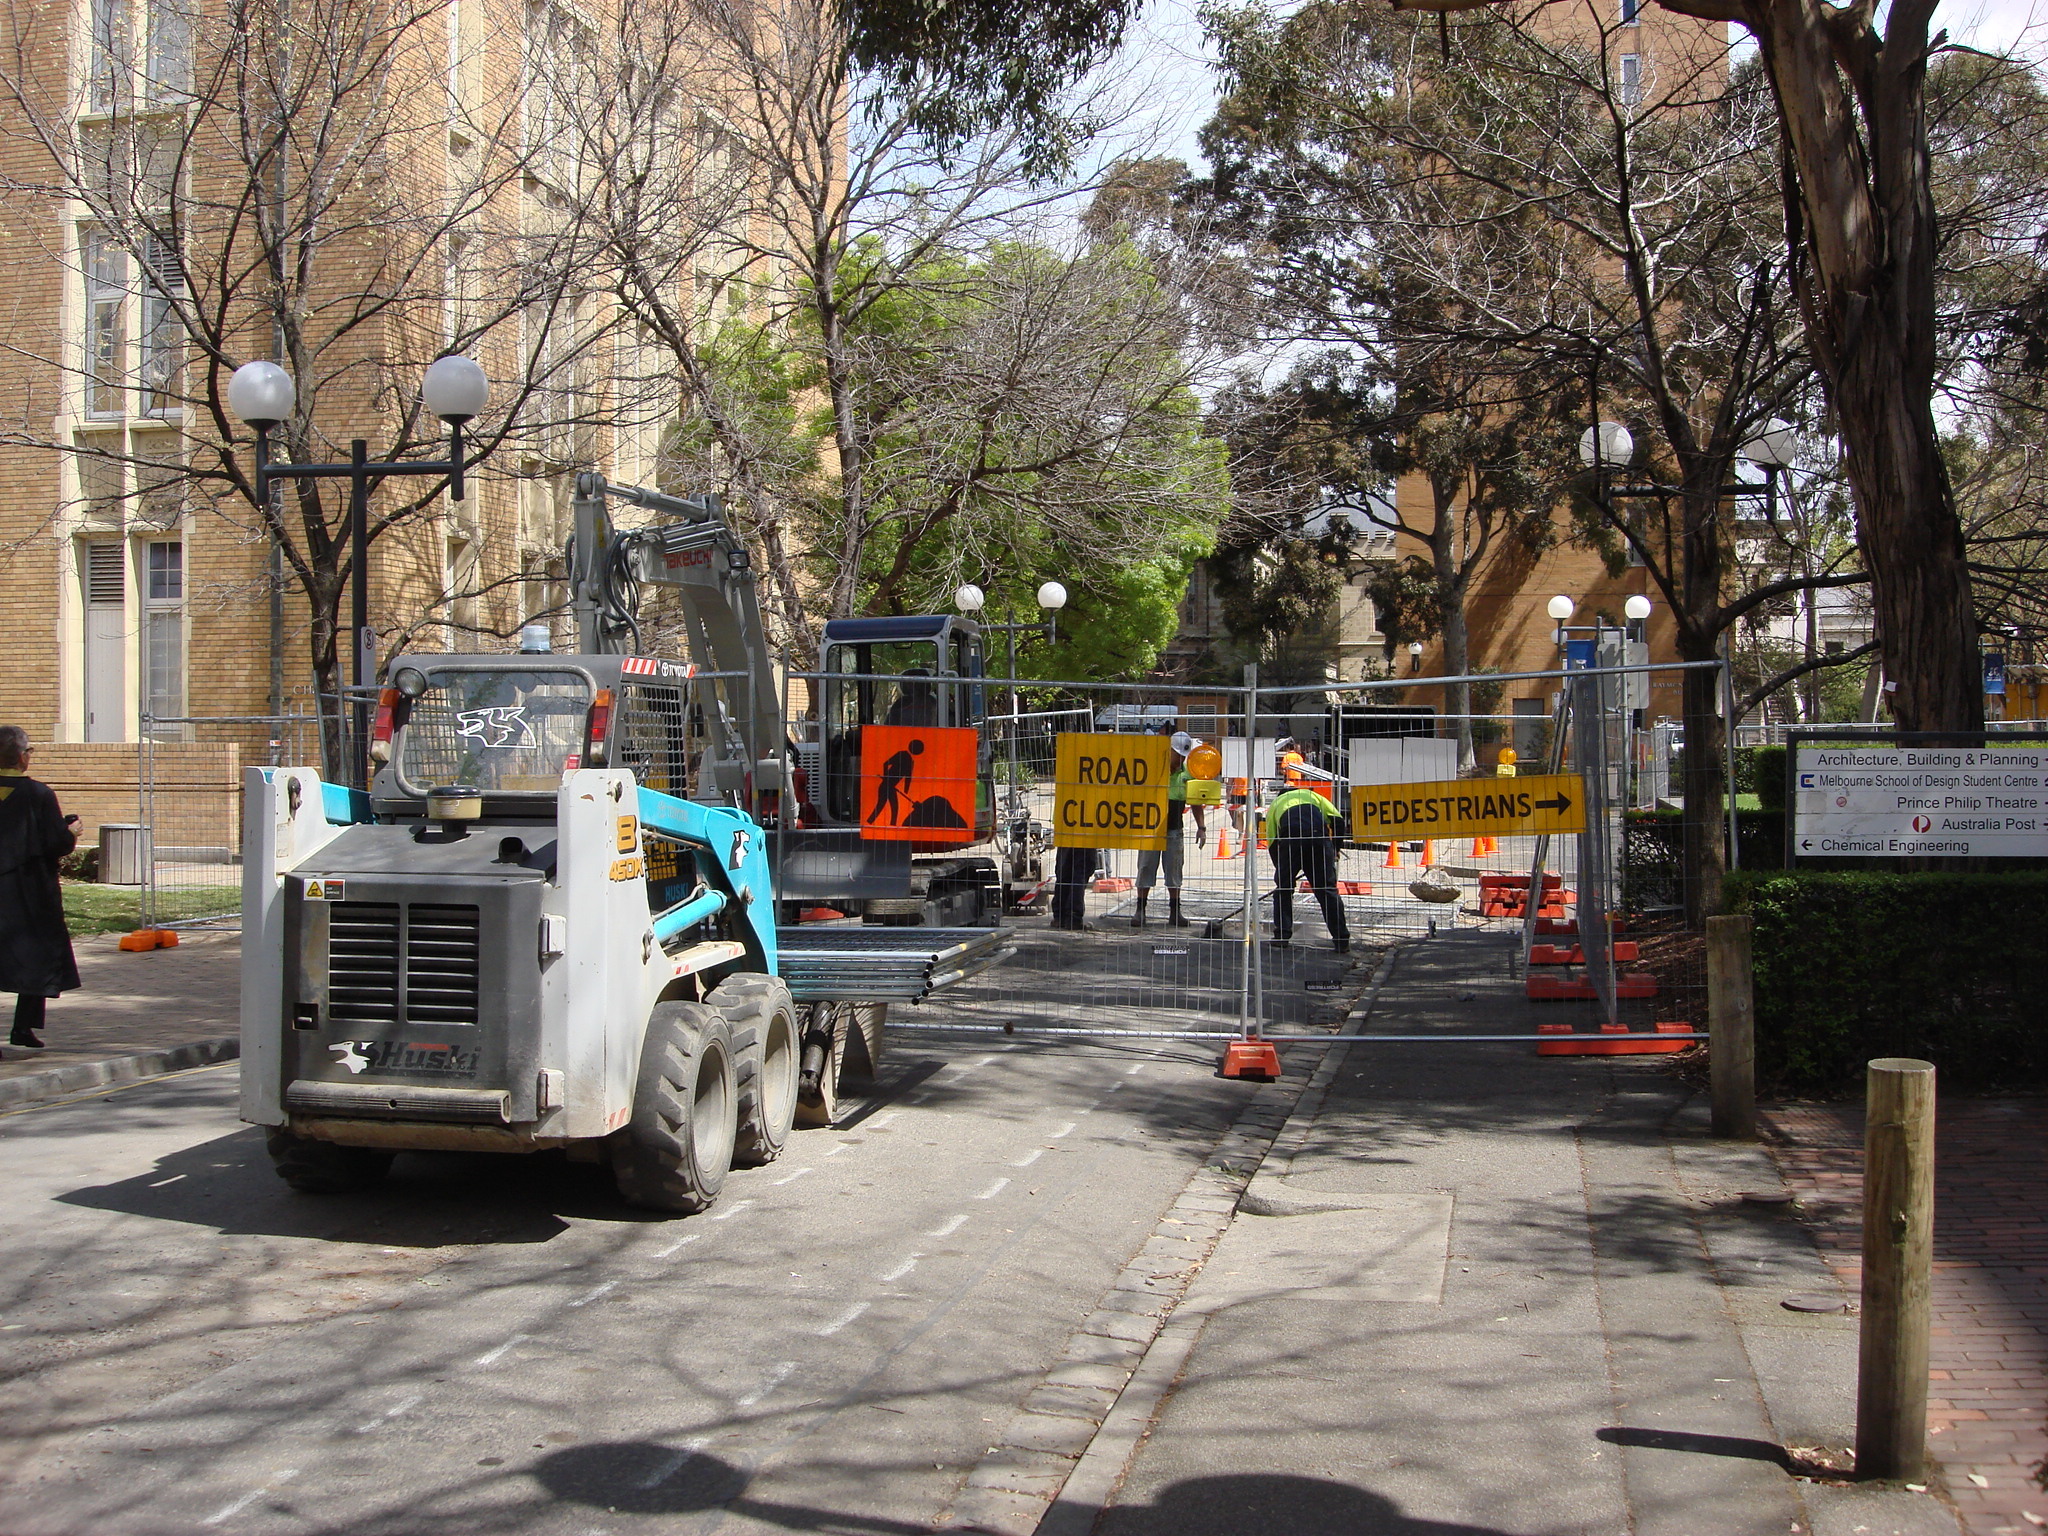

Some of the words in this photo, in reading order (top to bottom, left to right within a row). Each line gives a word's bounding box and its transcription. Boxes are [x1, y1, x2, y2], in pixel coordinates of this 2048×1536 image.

[1078, 756, 1148, 785] ROAD
[1817, 753, 1902, 766] Architecture,
[1907, 753, 1961, 768] Building
[1965, 753, 1975, 765] &
[1980, 753, 2039, 768] Planning
[1820, 774, 1873, 786] Melbourne
[1875, 774, 1910, 787] School
[1912, 775, 1923, 787] of
[1925, 774, 1960, 789] Design
[1963, 774, 2002, 787] Student
[2004, 774, 2038, 787] Centre
[1363, 792, 1532, 826] PEDESTRIANS
[1898, 796, 1940, 808] Prince
[1945, 796, 1981, 811] Philip
[1985, 796, 2038, 808] Theatre
[1062, 799, 1161, 830] CLOSED
[1942, 818, 2001, 830] Australia
[2005, 817, 2036, 830] Post
[617, 814, 637, 855] 8
[1821, 839, 1884, 851] Chemical
[1888, 839, 1969, 854] Engineering
[664, 882, 689, 903] HUSKI
[377, 1041, 482, 1071] Huski
